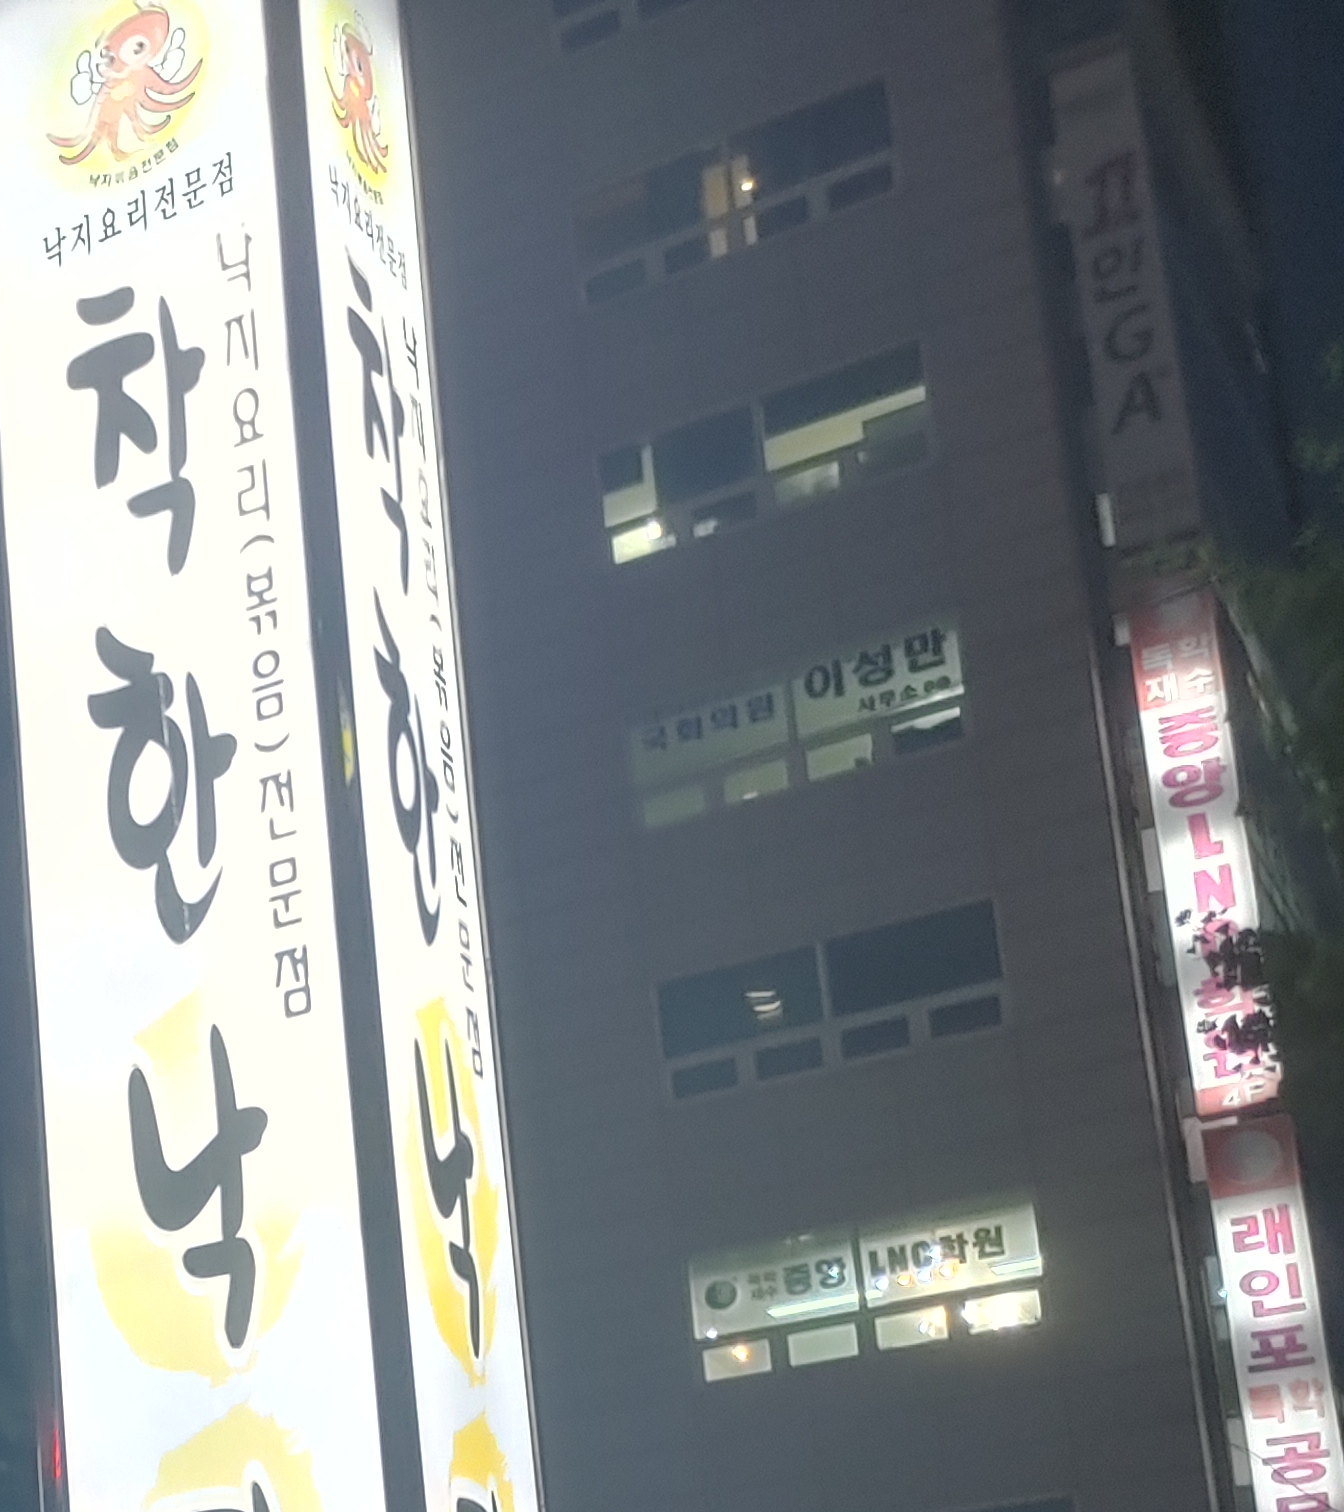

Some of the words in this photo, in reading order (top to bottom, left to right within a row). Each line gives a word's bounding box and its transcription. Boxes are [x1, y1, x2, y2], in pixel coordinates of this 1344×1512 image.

[42, 151, 236, 268] 낙지요리전문점
[803, 628, 948, 699] 이성만
[1144, 668, 1216, 703] 재수
[782, 1257, 848, 1296] 중앙
